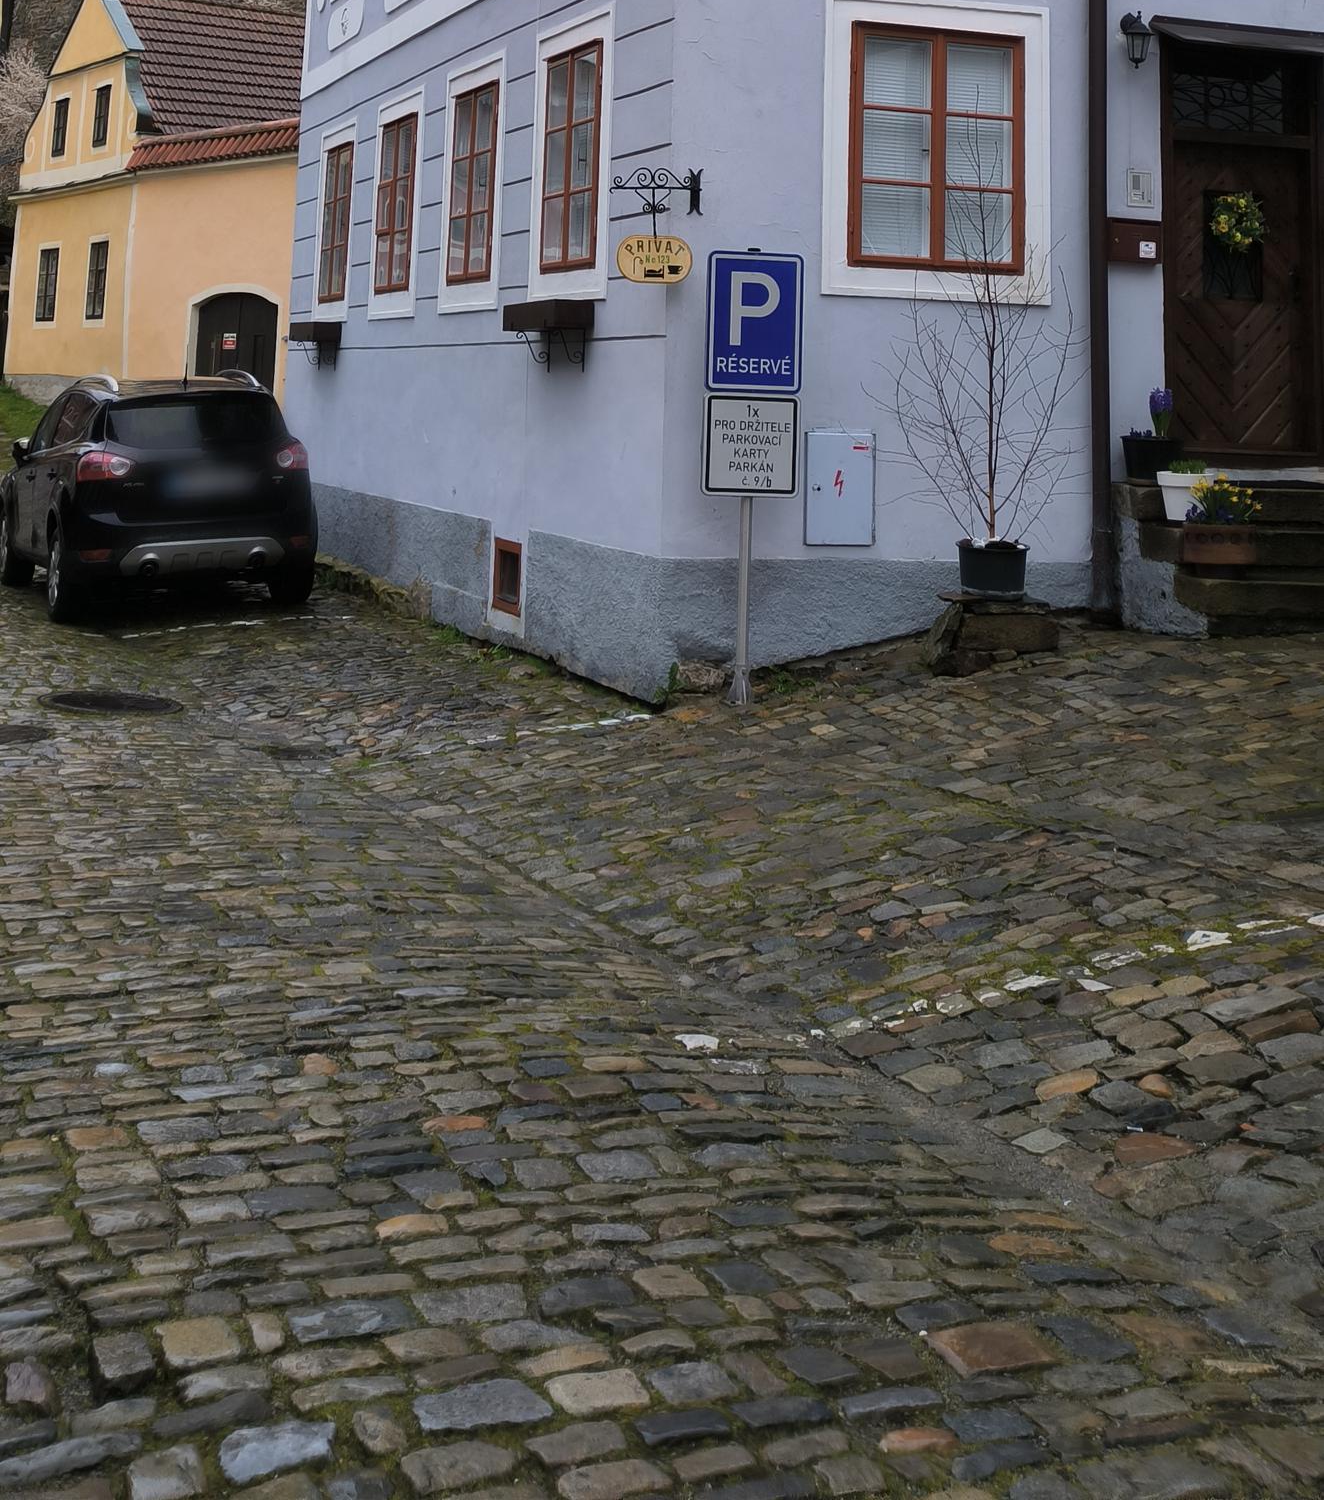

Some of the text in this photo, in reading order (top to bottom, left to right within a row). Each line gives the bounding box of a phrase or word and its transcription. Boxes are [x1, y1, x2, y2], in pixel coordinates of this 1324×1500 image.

[624, 240, 685, 256] PRIVAT
[657, 255, 670, 264] 123
[730, 271, 780, 346] P
[717, 353, 791, 375] RÉSERVÉ
[747, 404, 760, 418] 1x
[714, 419, 792, 433] PRO DRŽITELE
[722, 433, 782, 446] PARKOVACÍ
[733, 447, 769, 459] KARTY
[728, 460, 774, 473] PARKÁN
[754, 476, 772, 488] 9/b
